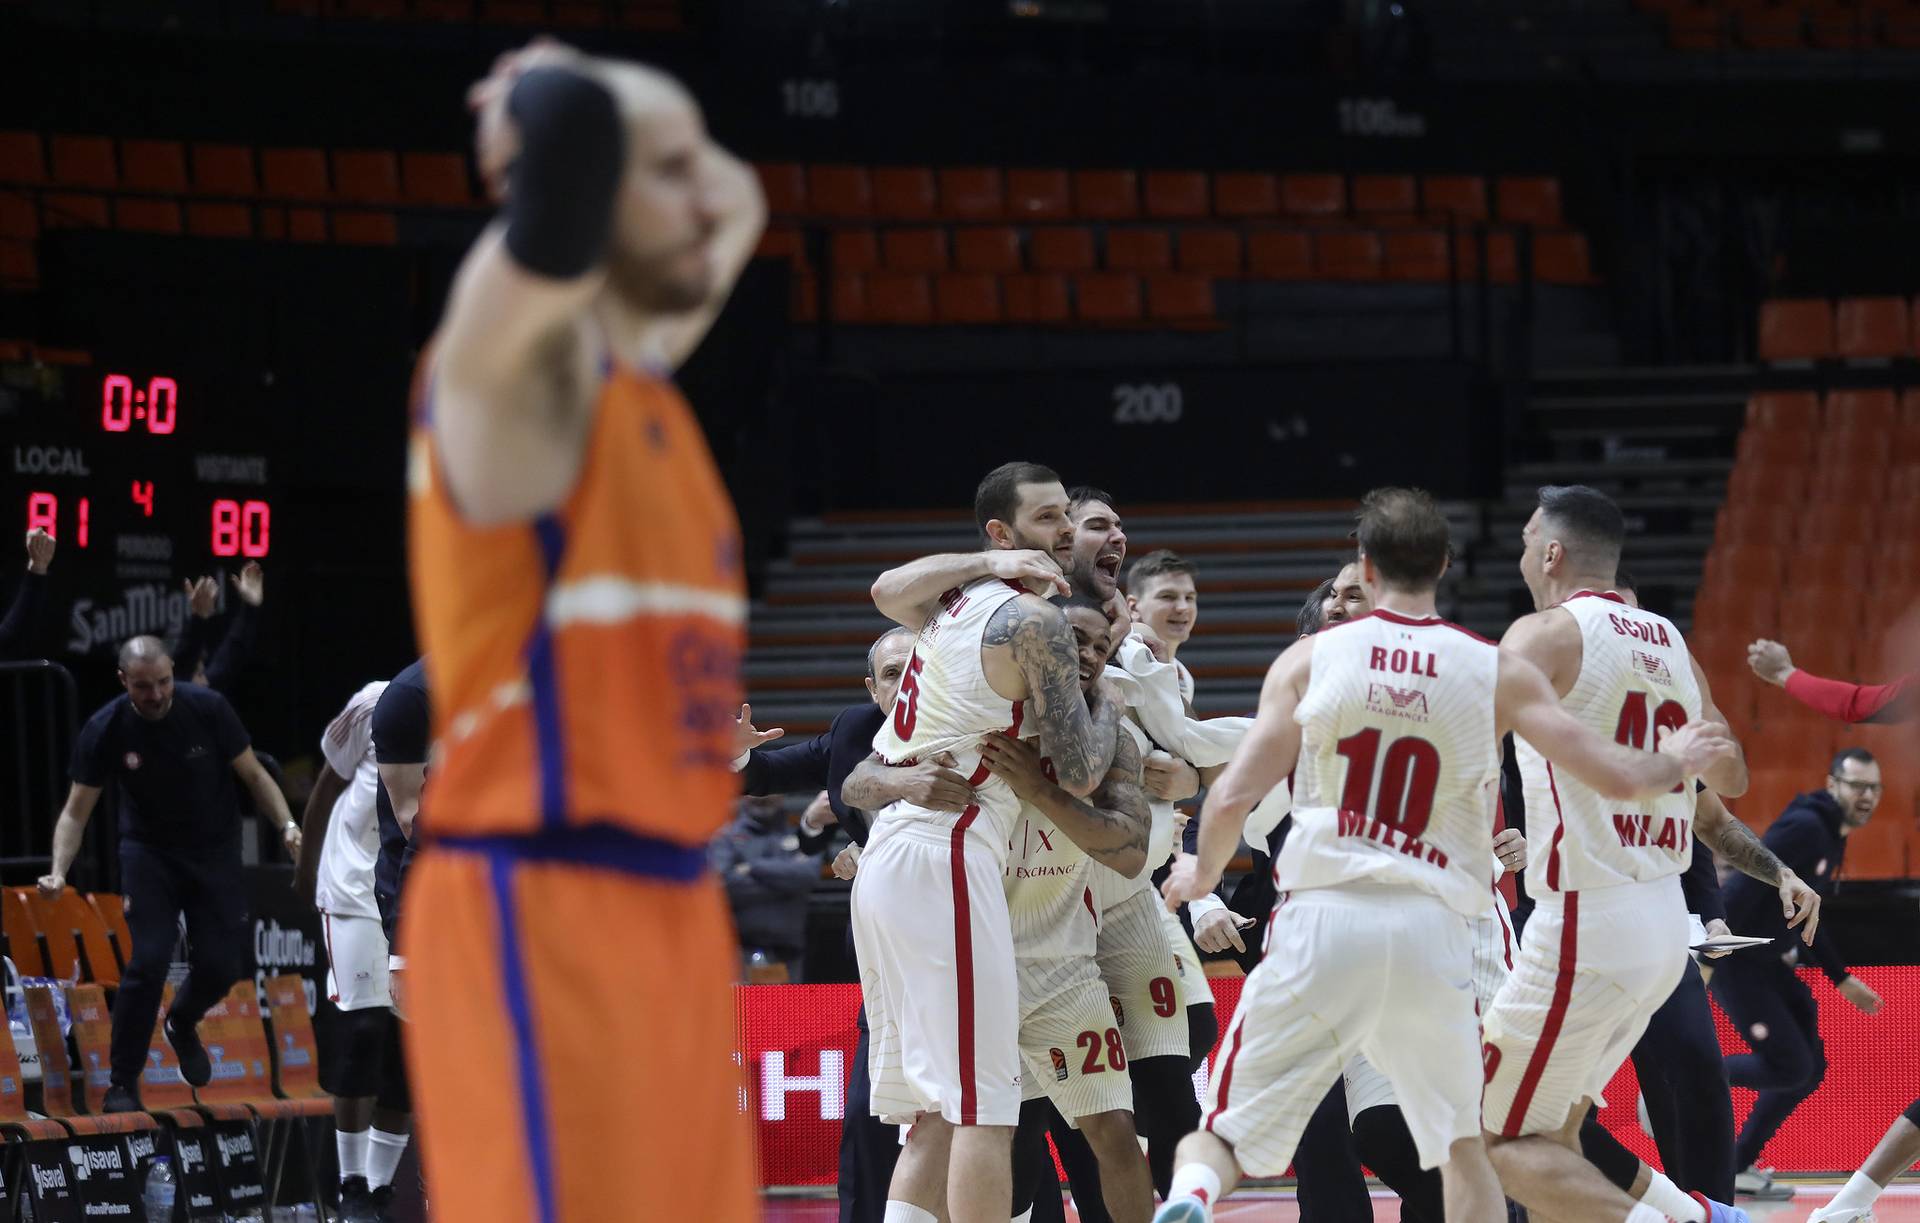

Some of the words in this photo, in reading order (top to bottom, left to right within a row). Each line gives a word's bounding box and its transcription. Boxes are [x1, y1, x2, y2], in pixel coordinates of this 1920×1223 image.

[103, 374, 177, 434] 0:0
[1112, 382, 1183, 424] 200
[14, 446, 90, 477] LOCAL
[131, 479, 154, 516] 4
[28, 491, 90, 549] 81
[211, 499, 271, 557] 80
[1608, 613, 1672, 648] SCOLA
[1369, 645, 1438, 678] ROLL
[1365, 704, 1429, 723] FRAGRANCES
[1335, 727, 1440, 838] 10
[1149, 976, 1176, 1018] 9
[1076, 1027, 1126, 1075] 28
[761, 1050, 845, 1121] H
[39, 1162, 67, 1188] isaval
[86, 1145, 123, 1170] isaval
